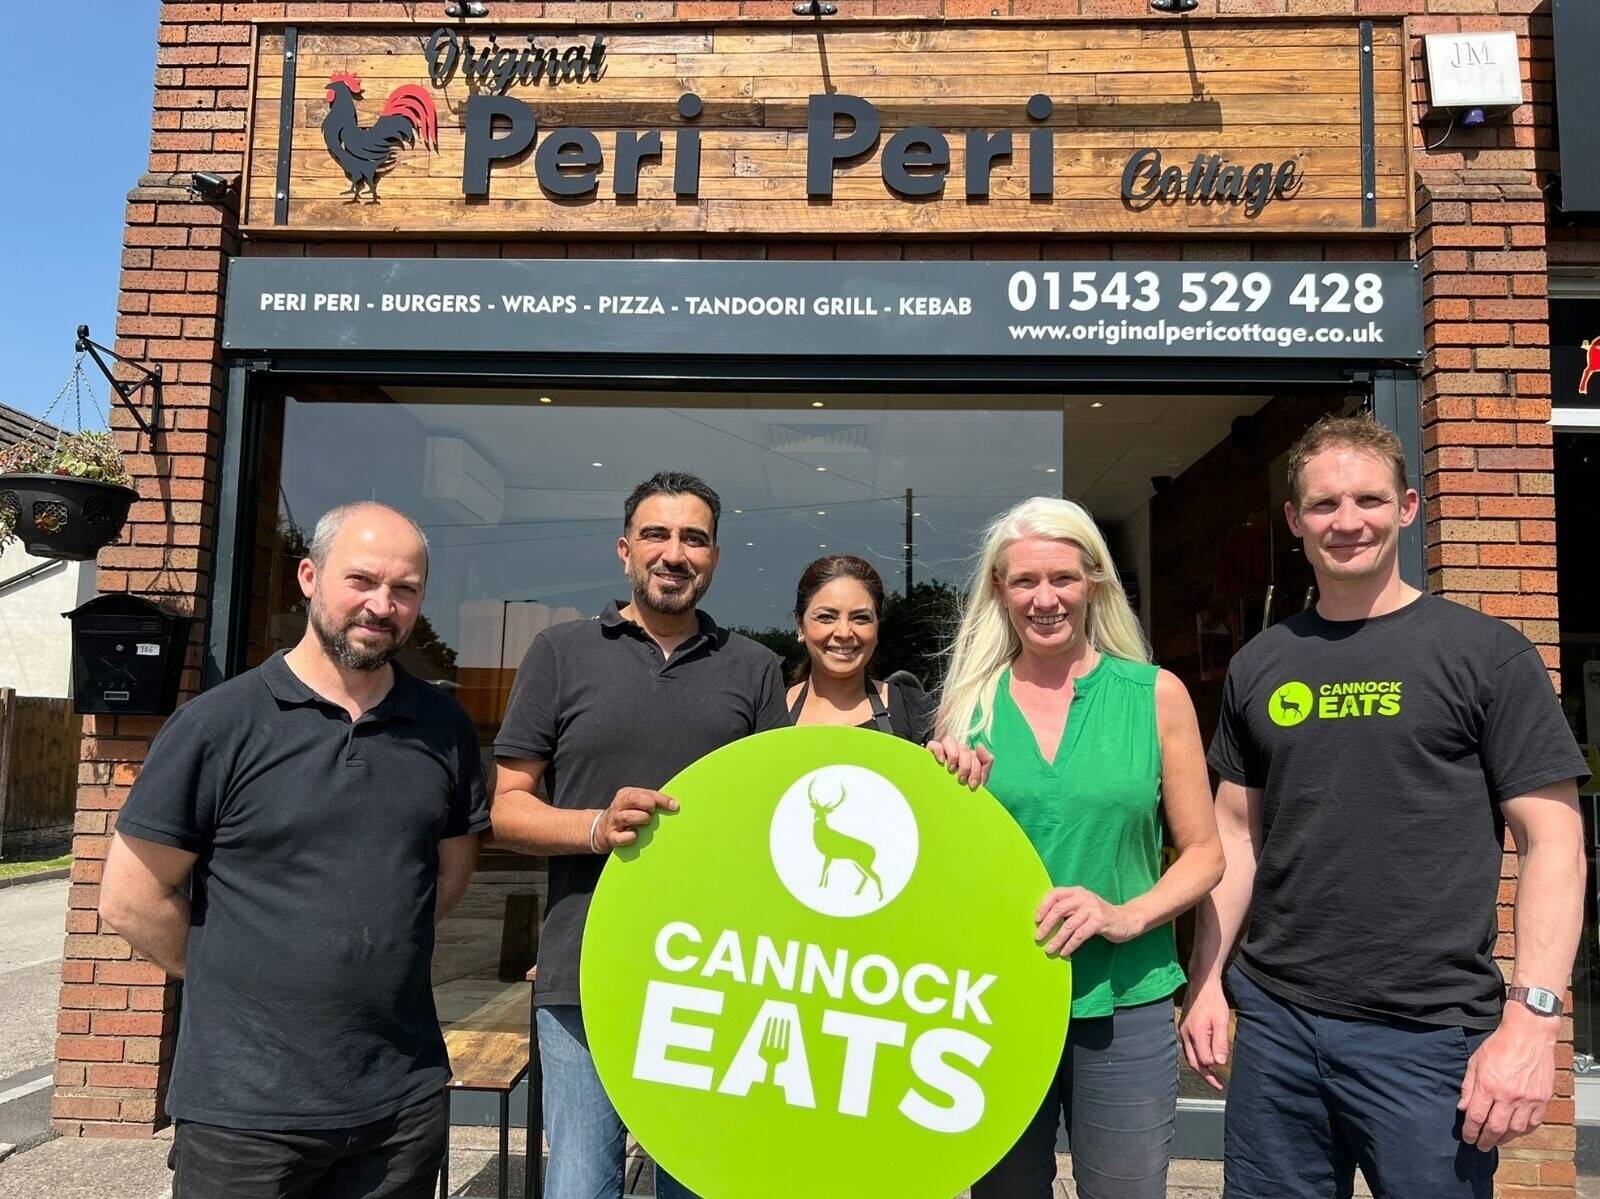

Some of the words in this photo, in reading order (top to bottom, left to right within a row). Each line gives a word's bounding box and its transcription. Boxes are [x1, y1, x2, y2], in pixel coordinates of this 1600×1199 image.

[425, 28, 607, 91] Original
[462, 93, 702, 195] Peri
[806, 94, 1054, 195] Peri
[1121, 148, 1304, 210] Cottage
[260, 293, 307, 312] PERI
[313, 293, 361, 312] PERI
[381, 293, 481, 314] BURGERS
[501, 294, 577, 315] WRAPS
[598, 295, 666, 315] PIZZA
[684, 295, 806, 316] TANDOORI
[812, 296, 878, 317] GRILL
[898, 296, 972, 317] KEBAB
[1007, 270, 1161, 312] 01543
[1177, 271, 1272, 313] 529
[1288, 272, 1384, 314] 428
[1008, 319, 1384, 348] www.originalpericottage.co.uk
[1319, 694, 1401, 718] EATS
[1320, 682, 1402, 695] CANNOCK
[655, 921, 998, 1025] CANNOCK
[632, 980, 992, 1133] EATS
